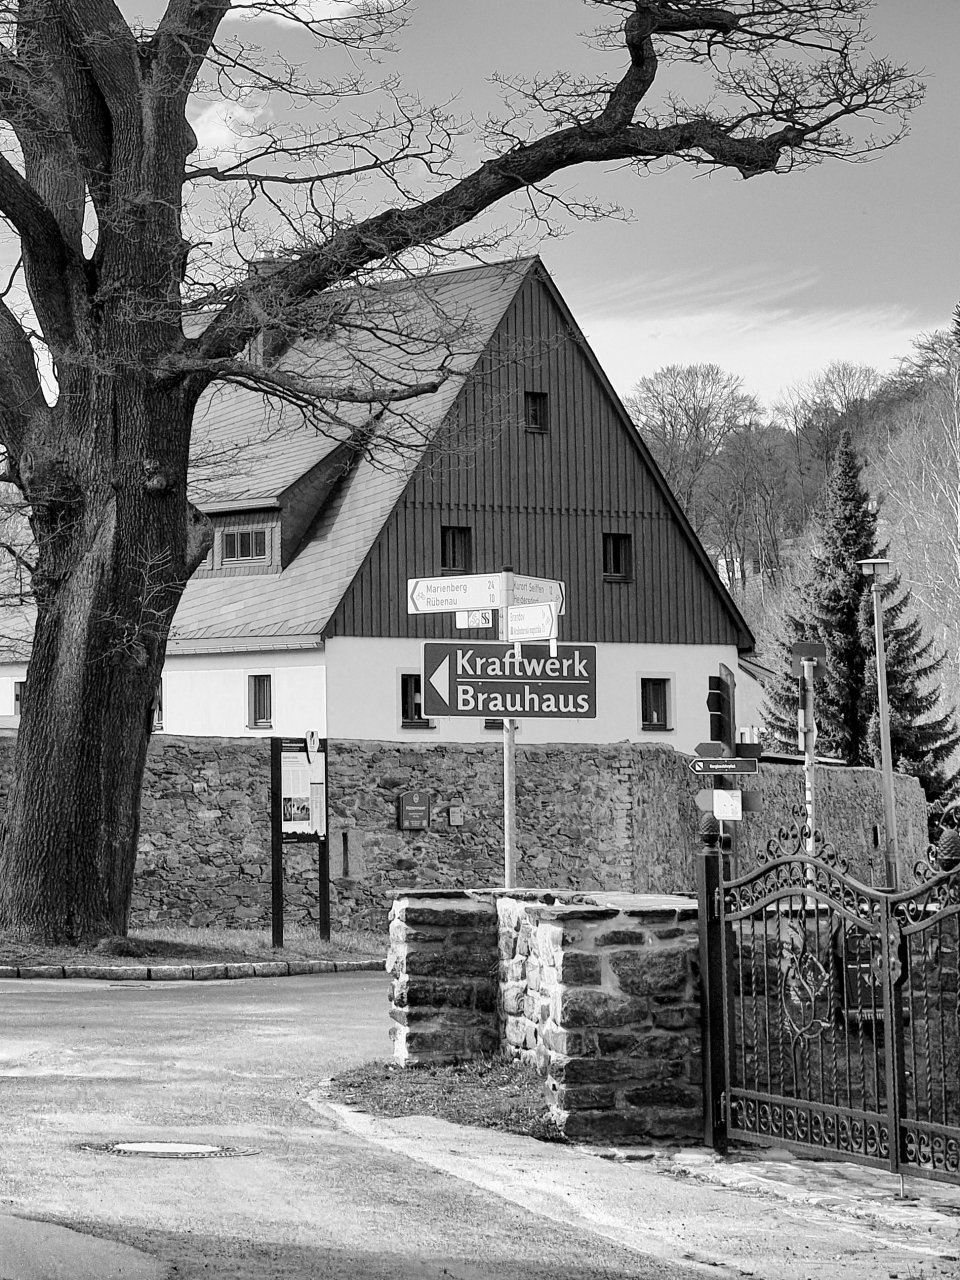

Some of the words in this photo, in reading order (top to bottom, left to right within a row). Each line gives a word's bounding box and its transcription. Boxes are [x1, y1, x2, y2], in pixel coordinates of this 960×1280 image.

[426, 582, 468, 594] Marienberg
[487, 579, 495, 590] 24
[426, 596, 458, 607] Rübenau
[456, 649, 589, 677] Kraftwerk
[457, 685, 590, 713] Brauhaus
